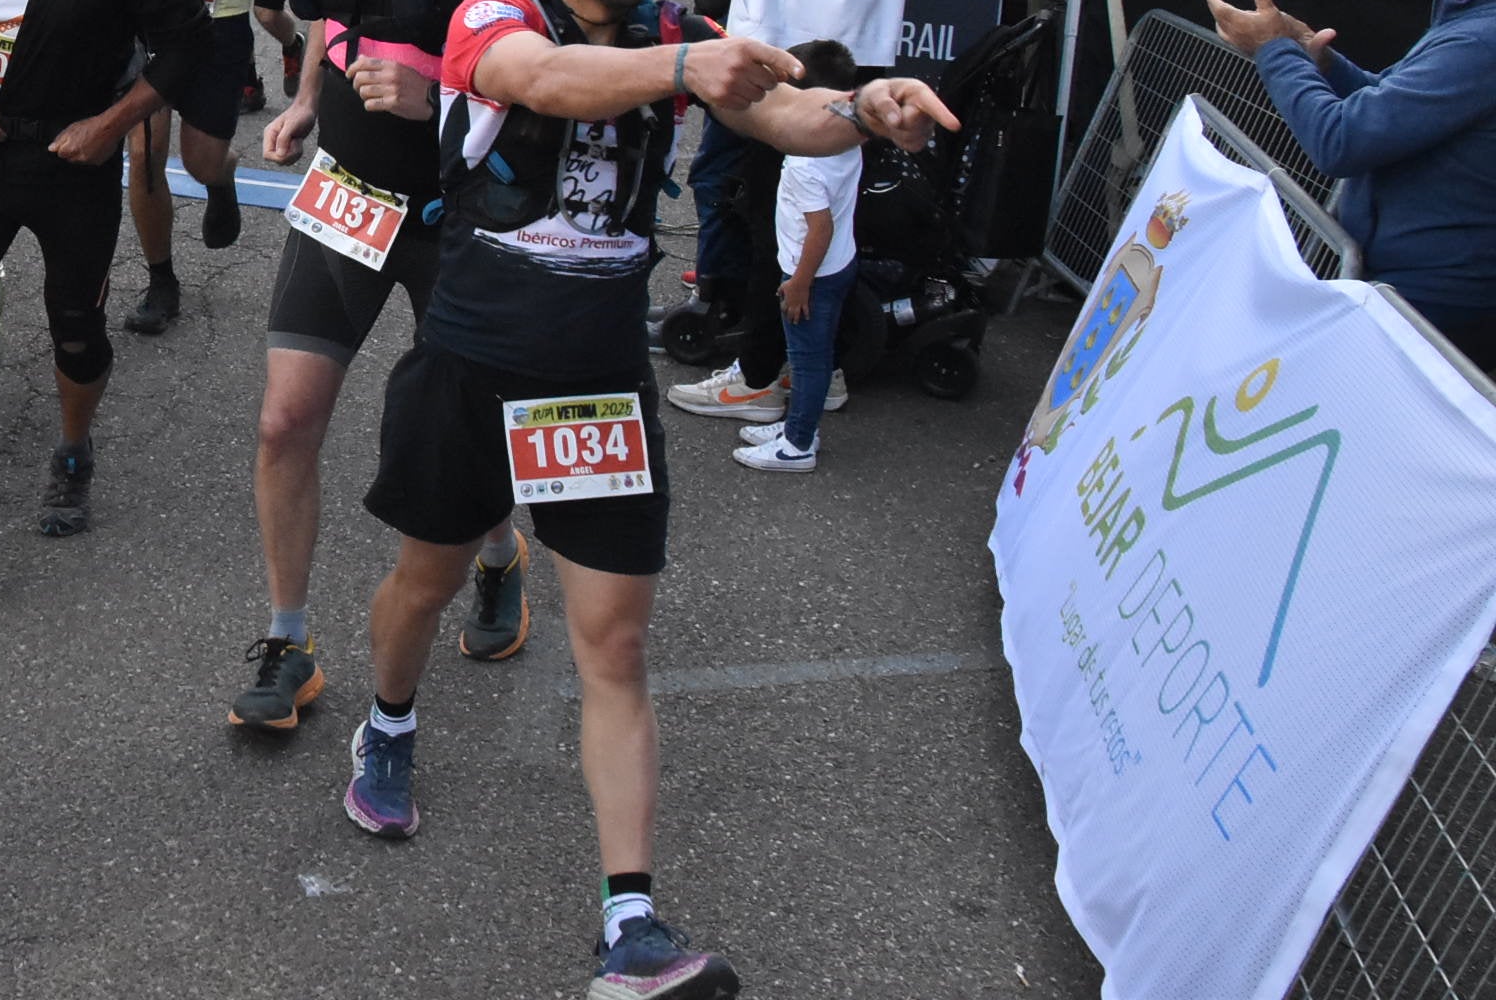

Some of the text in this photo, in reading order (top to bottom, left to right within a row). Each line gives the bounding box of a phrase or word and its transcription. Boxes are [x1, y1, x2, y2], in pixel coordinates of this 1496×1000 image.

[897, 20, 958, 61] RAIL
[314, 179, 386, 237] 1031
[516, 229, 635, 250] Ibéricos Premium
[556, 403, 598, 420] VETONA
[600, 401, 634, 417] 2025
[527, 423, 629, 468] 1034
[1117, 548, 1277, 842] DEPORTE
